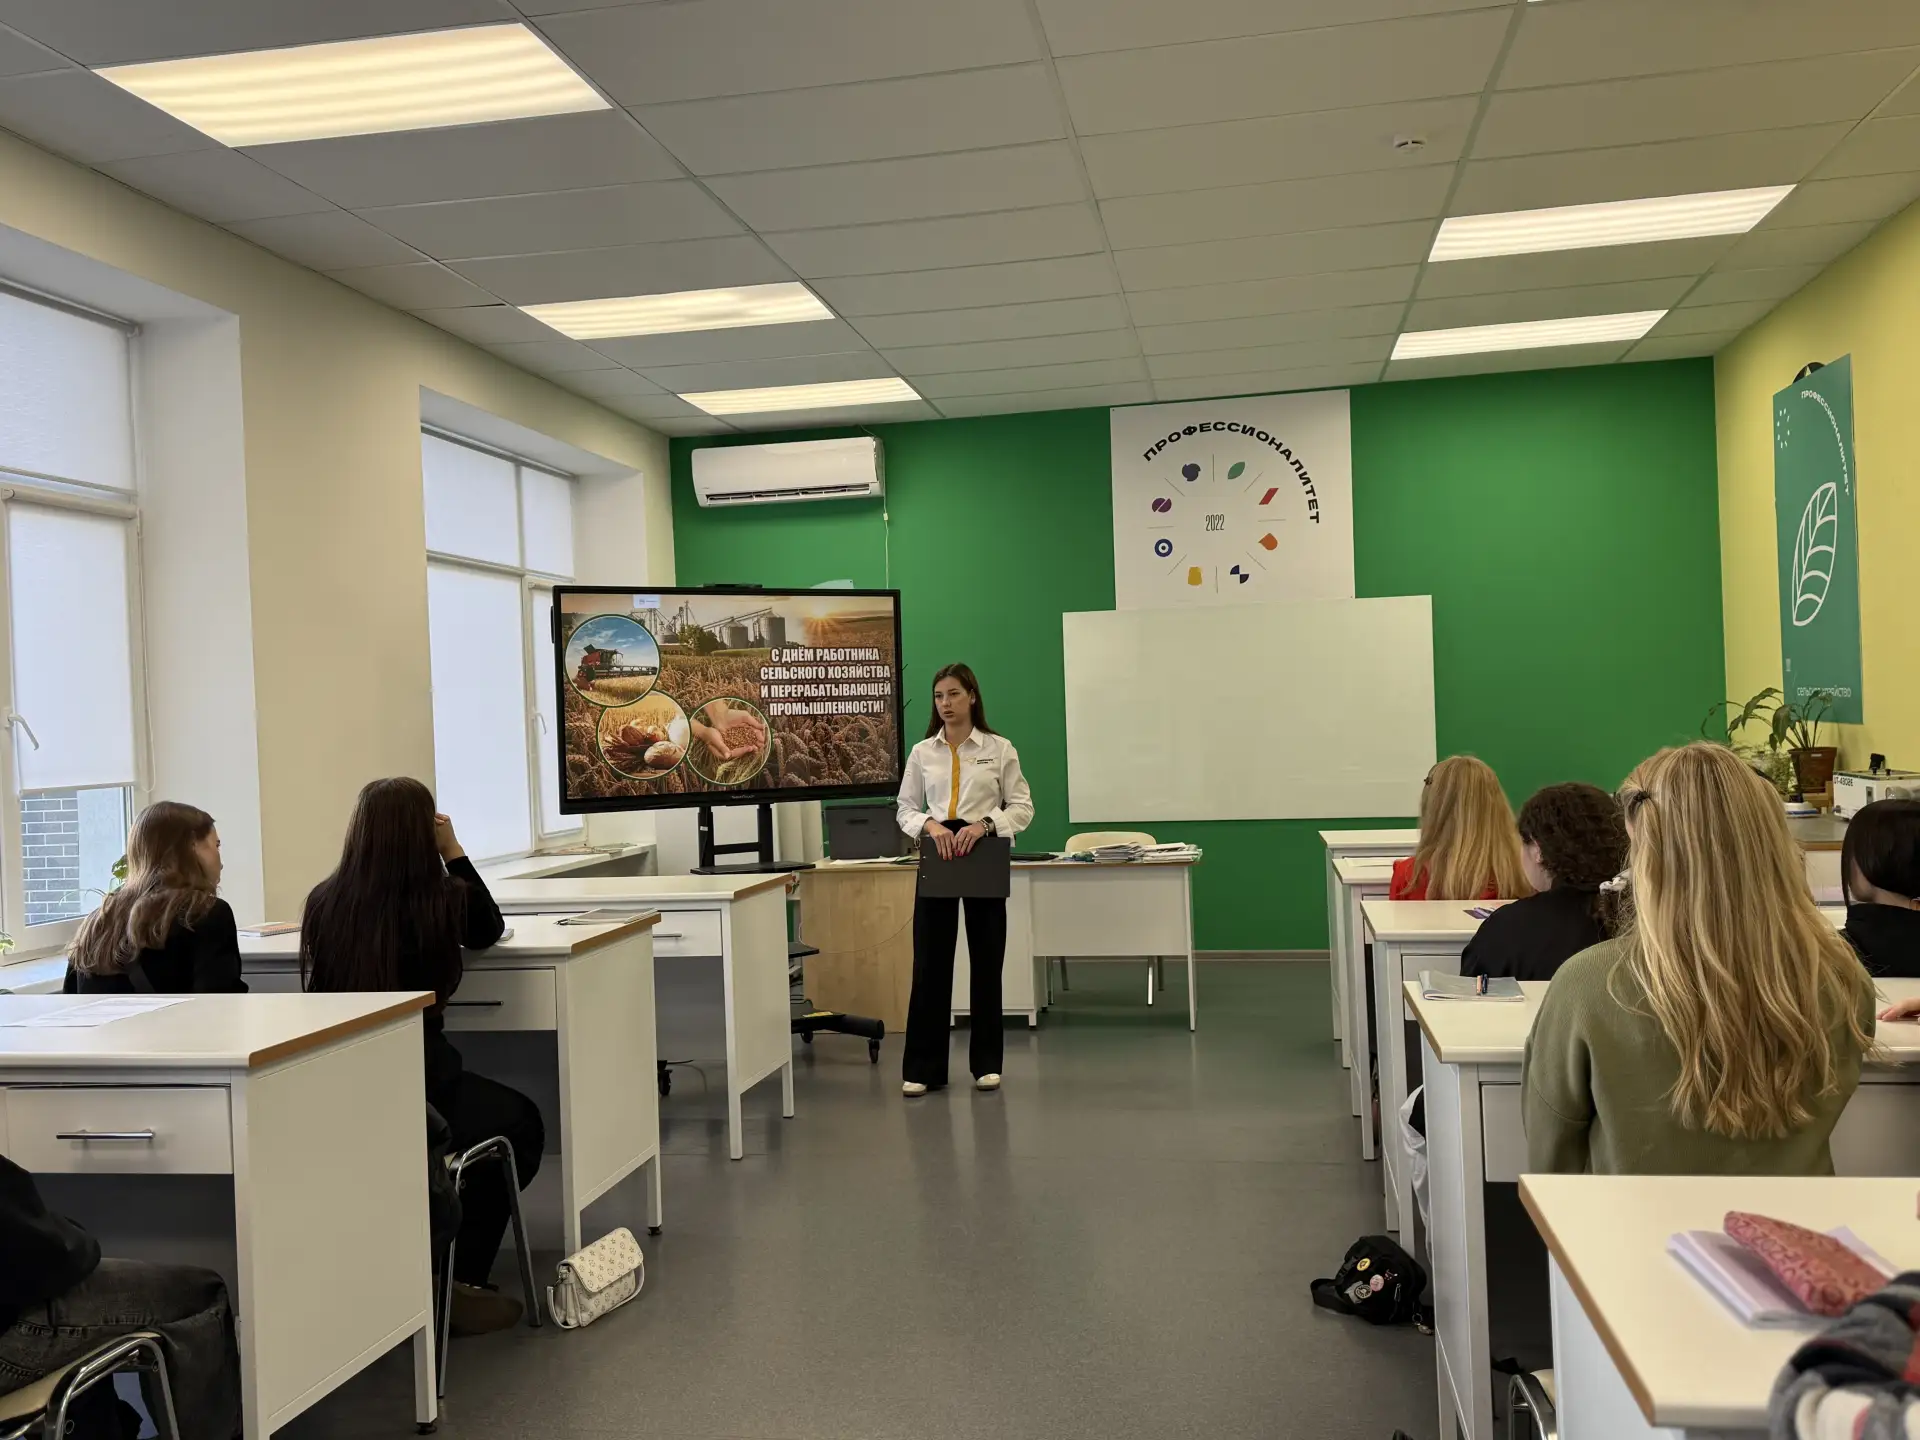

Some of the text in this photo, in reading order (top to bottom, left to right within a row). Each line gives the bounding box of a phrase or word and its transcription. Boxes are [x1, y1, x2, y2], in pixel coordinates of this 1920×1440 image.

[1142, 421, 1320, 524] ПРОФЕССИОНАЛИТЕТ
[1205, 514, 1225, 532] 2022
[771, 646, 880, 663] С ДНЁМ РАБОТНИКА
[760, 664, 891, 680] СЕЛЬСКОГО ХОЗЯЙСТВА
[760, 681, 891, 698] И ПЕРЕРАБАТЫВАЮЩЕЙ
[769, 700, 885, 716] ПРОМЫШЛЕННОСТИ!
